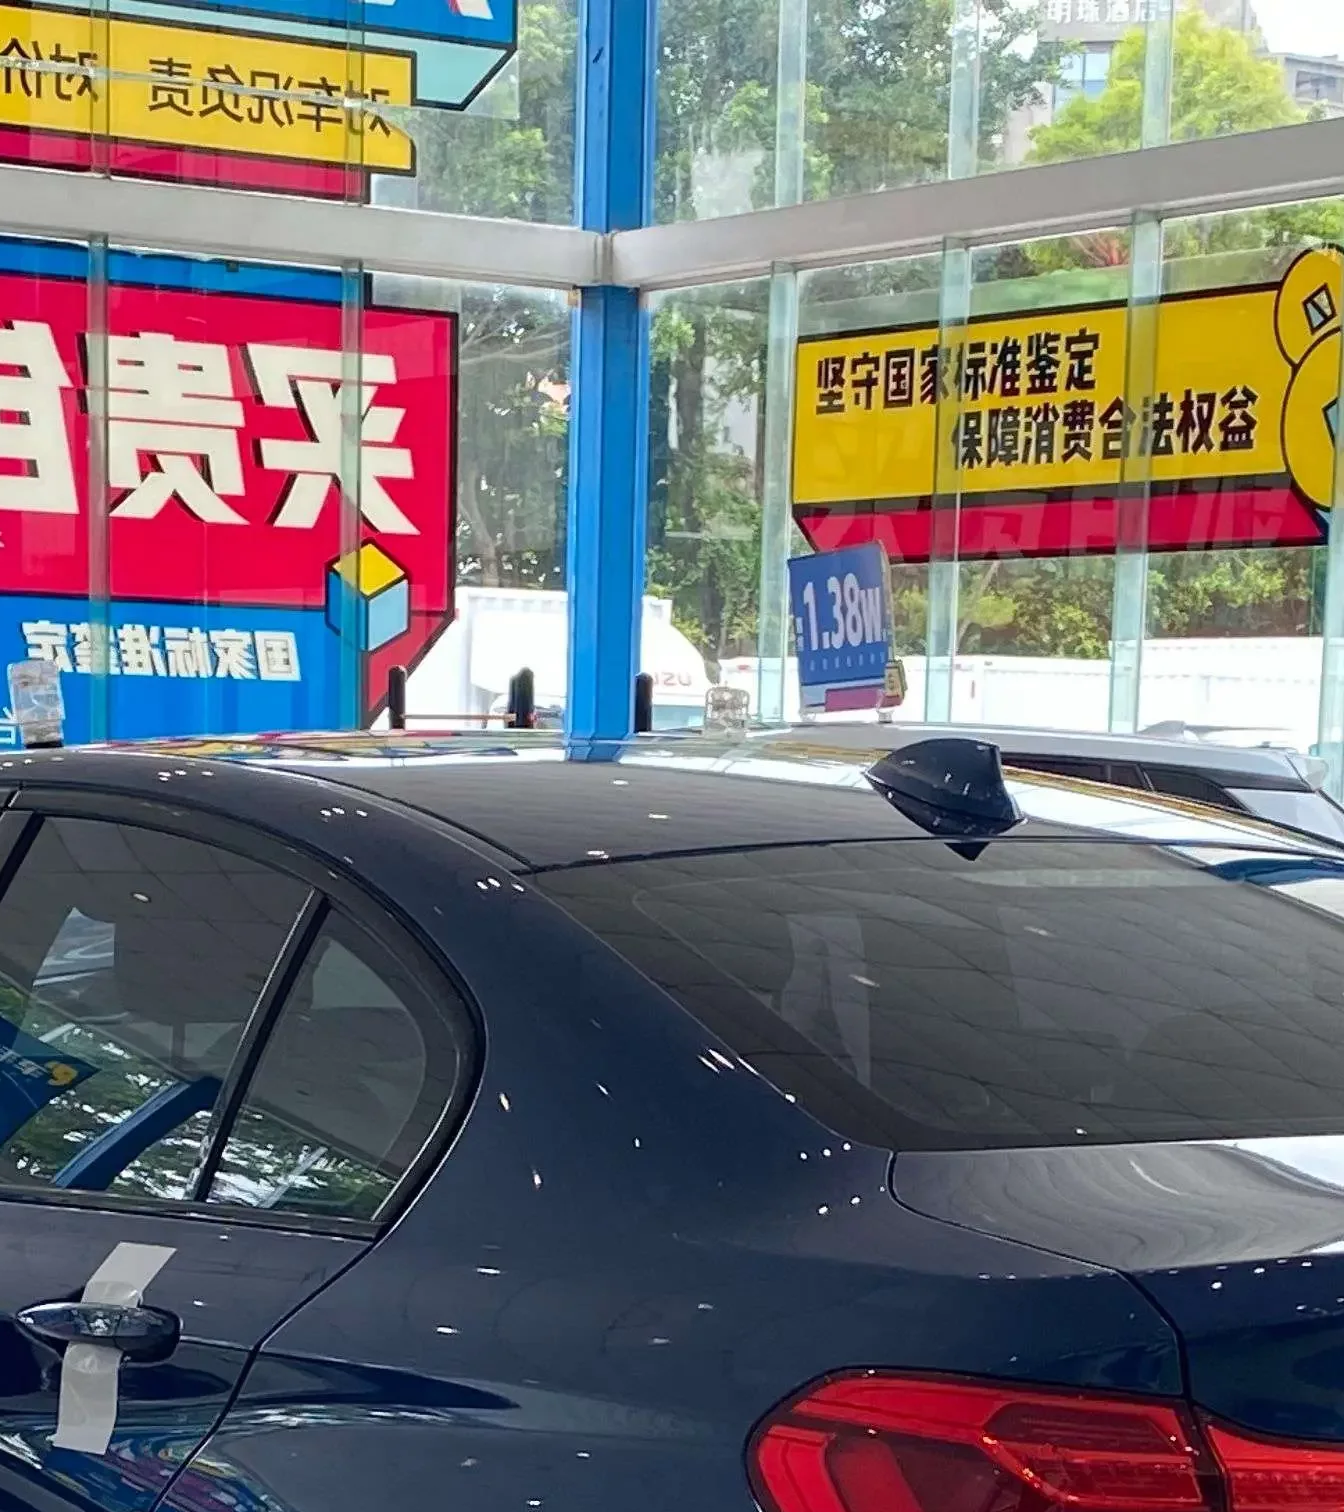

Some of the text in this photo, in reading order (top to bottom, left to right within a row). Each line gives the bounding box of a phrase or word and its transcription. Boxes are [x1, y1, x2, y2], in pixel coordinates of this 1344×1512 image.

[815, 326, 1101, 415] 坚守国家标准鉴定
[951, 384, 1259, 470] 保障消费合法权益
